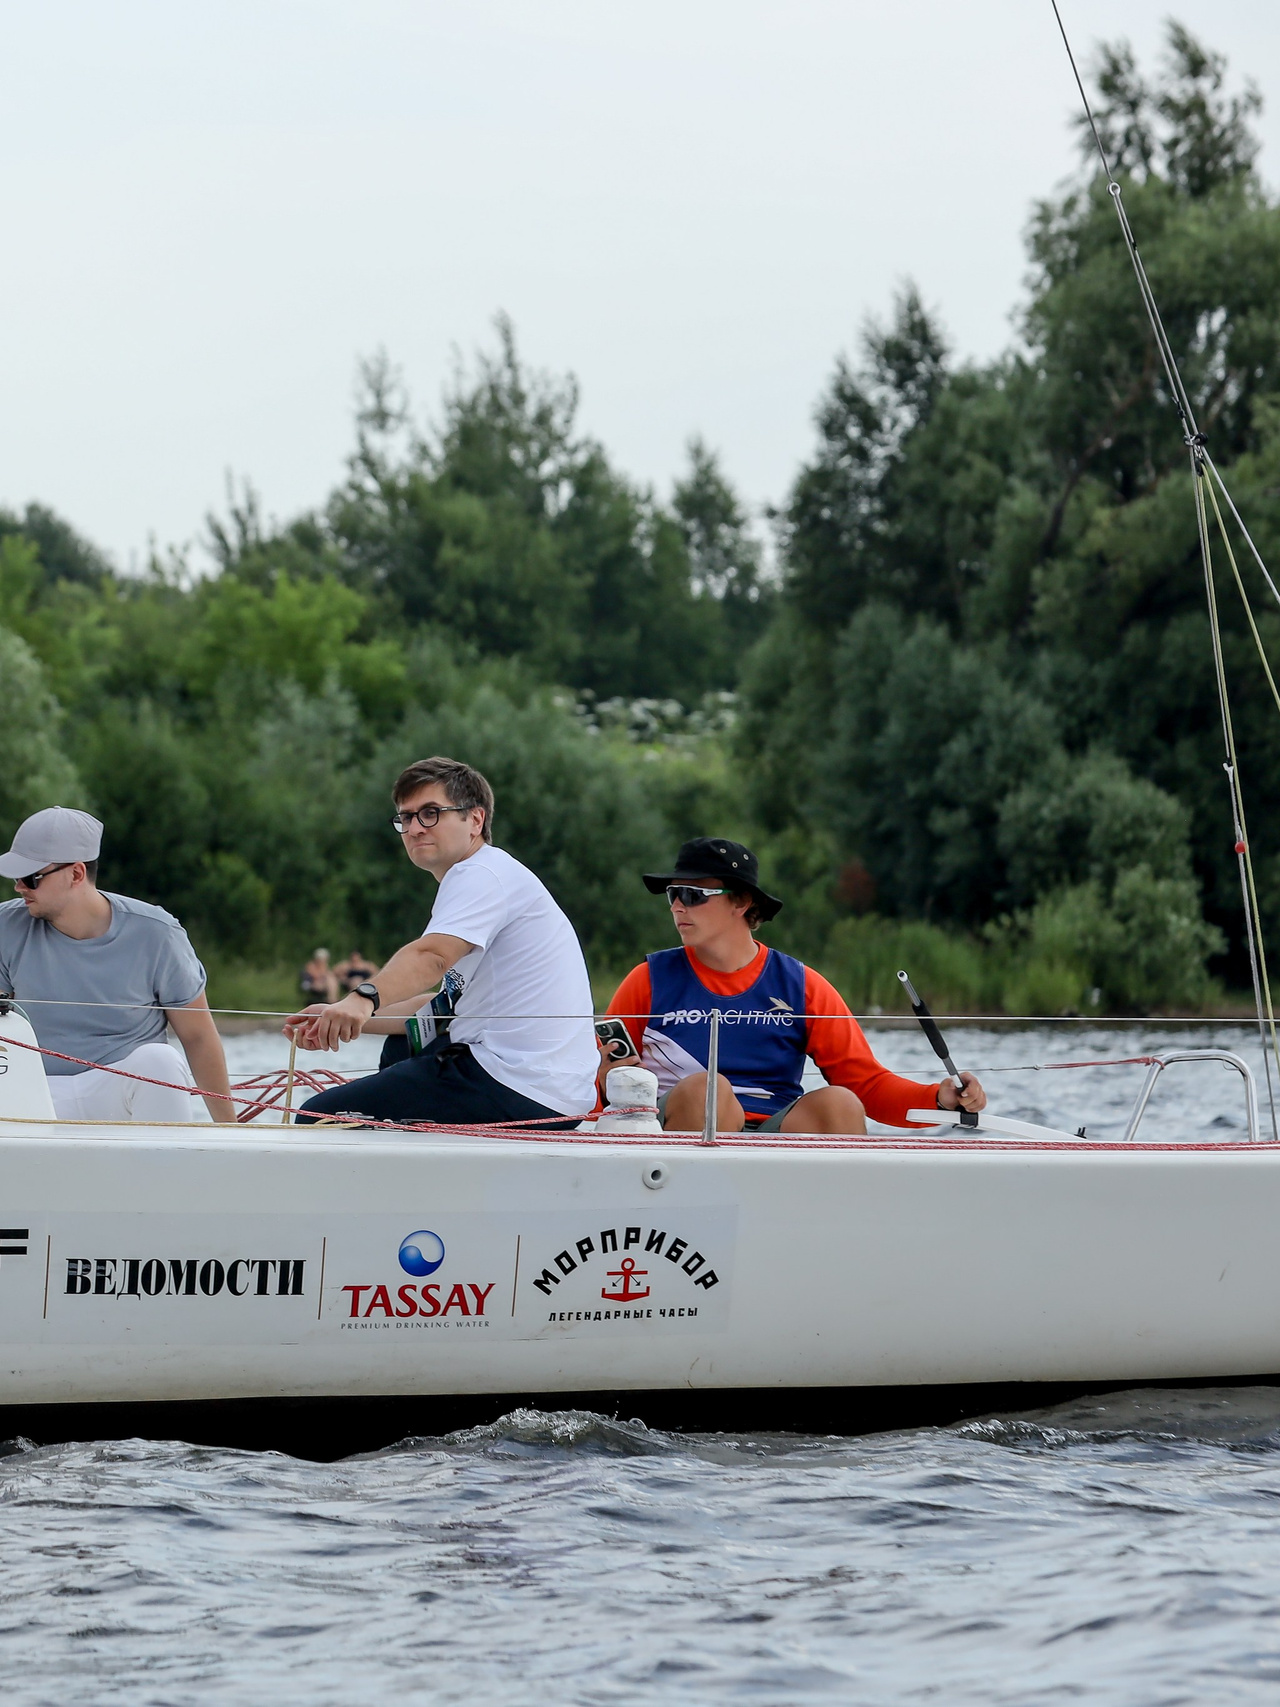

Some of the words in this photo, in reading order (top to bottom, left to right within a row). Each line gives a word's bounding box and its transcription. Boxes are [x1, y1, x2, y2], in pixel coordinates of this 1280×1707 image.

[532, 1226, 720, 1296] МОРПРИБОР
[63, 1257, 307, 1300] ВЕДОМОСТИ
[341, 1283, 496, 1317] TASSAY
[548, 1309, 653, 1322] ЛЕГЕНДАРНЫЕ
[659, 1307, 699, 1318] ЧАСЫ
[340, 1322, 391, 1330] PREMIUM
[395, 1321, 451, 1329] DRINKING
[455, 1320, 491, 1328] WATER
